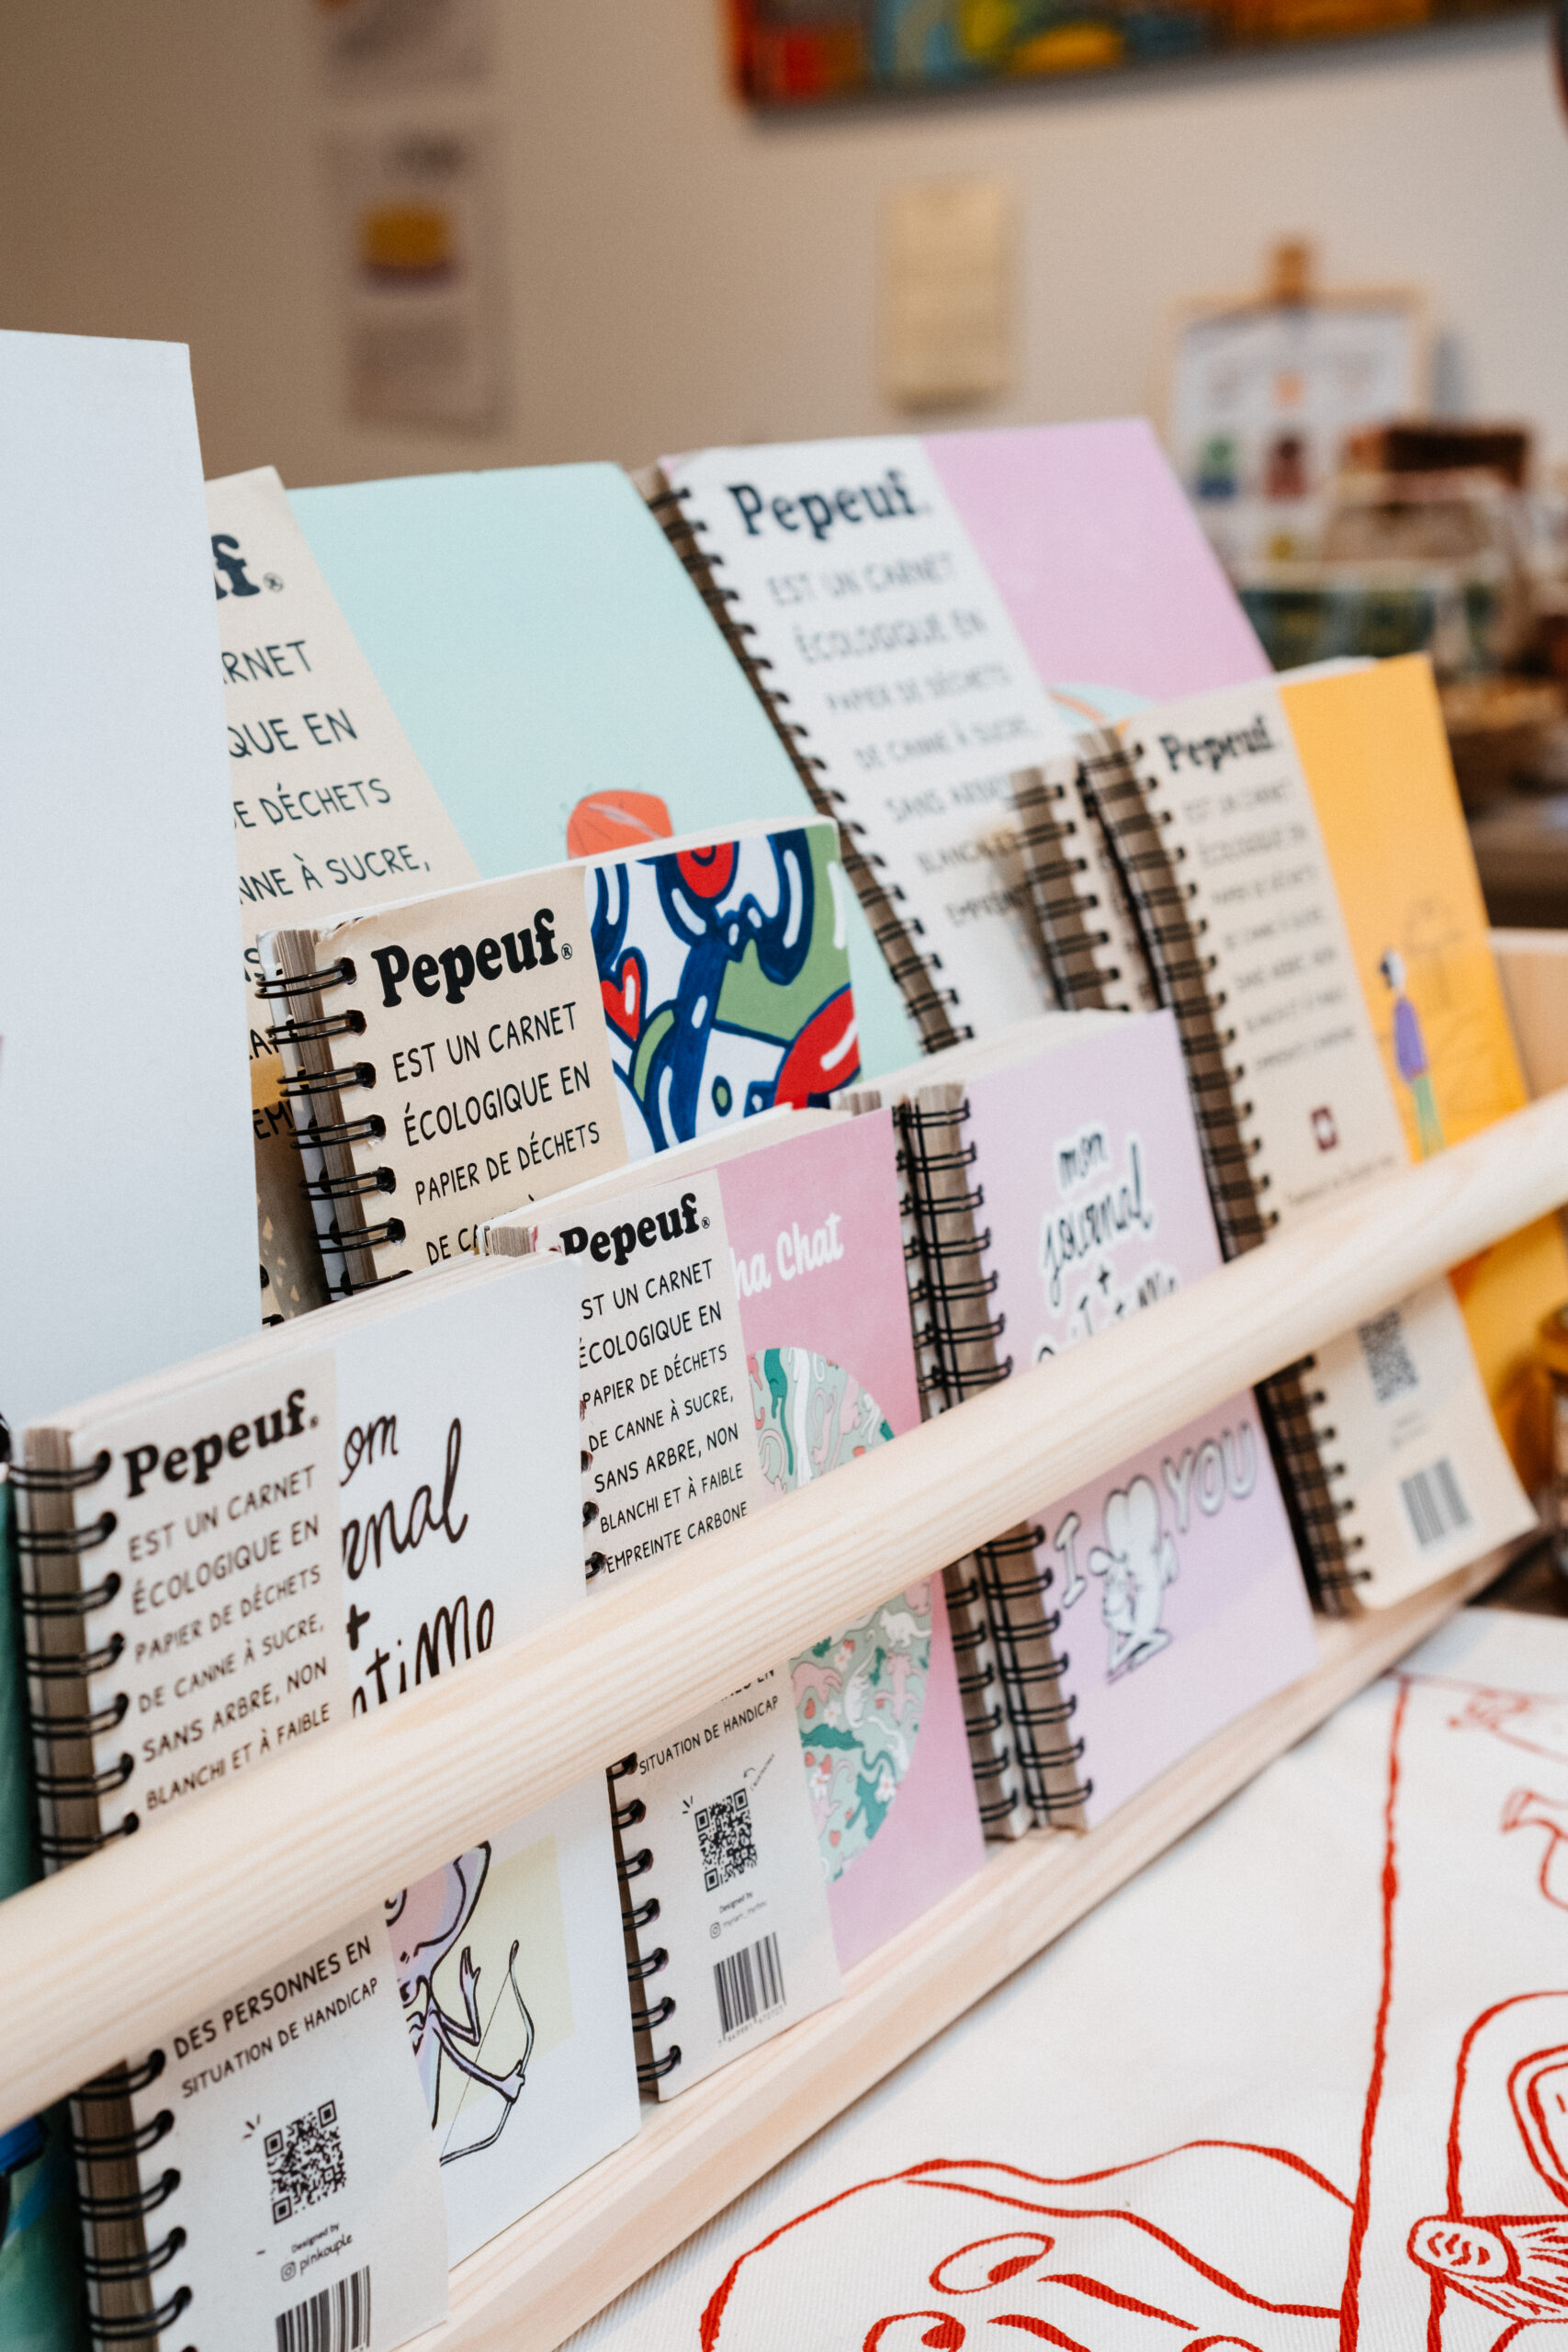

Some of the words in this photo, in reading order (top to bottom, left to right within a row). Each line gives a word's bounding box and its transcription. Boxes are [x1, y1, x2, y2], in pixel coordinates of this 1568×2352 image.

[221, 640, 311, 684] RNET
[302, 708, 357, 745] EN
[233, 800, 256, 829] E
[259, 778, 390, 824] DÉCHETS
[239, 868, 294, 904] NNE
[293, 853, 323, 890] À
[326, 844, 430, 885] SUCRE,
[392, 1042, 435, 1082] EST
[446, 1030, 480, 1066] UN
[489, 1001, 577, 1054] CARNET
[404, 1071, 553, 1147] ÉCOLOGIQUE
[561, 1060, 591, 1096] EN
[414, 1162, 479, 1205] PAPIER
[486, 1150, 512, 1182] DE
[517, 1121, 600, 1170] DÉCHETS
[426, 1235, 452, 1265] DE
[776, 1212, 844, 1281] Chat
[581, 1294, 604, 1320] ST
[613, 1283, 639, 1309] UN
[646, 1259, 712, 1298] CARNET
[580, 1310, 693, 1368] ÉCOLOGIQUE
[698, 1301, 722, 1327] EN
[582, 1377, 635, 1407] PAPIER
[640, 1369, 660, 1391] DE
[663, 1344, 728, 1382] DÉCHETS
[589, 1430, 609, 1452] DE
[615, 1409, 665, 1442] CANNE
[670, 1398, 680, 1422] À
[684, 1385, 734, 1417] SUCRE,
[594, 1461, 639, 1493] SANS
[646, 1439, 703, 1475] ARBRE,
[706, 1422, 739, 1451] NON
[1163, 1420, 1258, 1533] YOU
[128, 1521, 175, 1563] EST
[185, 1505, 219, 1538] UN
[228, 1464, 315, 1521] CARNET
[600, 1496, 660, 1533] BLANCHI
[664, 1487, 682, 1509] ET
[688, 1476, 697, 1499] À
[701, 1463, 743, 1493] FAIBLE
[131, 1530, 281, 1615] ÉCOLOGIQUE
[290, 1514, 319, 1546] EN
[606, 1529, 682, 1574] EMPREINTE
[687, 1500, 748, 1540] CARBONE
[135, 1619, 202, 1664] PAPIER
[209, 1605, 232, 1633] DE
[240, 1565, 321, 1618] DÉCHETS
[138, 1685, 164, 1713] DE
[174, 1653, 236, 1699] CANNE
[243, 1638, 255, 1666] À
[141, 1718, 204, 1763] SANS
[211, 1682, 280, 1733] ARBRE,
[287, 1656, 328, 1693] NON
[146, 1757, 227, 1810] BLANCHI
[231, 1742, 253, 1771] ET
[259, 1728, 271, 1755] À
[276, 1702, 331, 1746] FAIBLE
[638, 1732, 702, 1776] SITUATION
[704, 1724, 721, 1748] DE
[724, 1695, 780, 1735] HANDICAP
[174, 2019, 218, 2059] DES
[223, 1952, 342, 2032] PERSONNES
[346, 1936, 372, 1965] EN
[181, 2038, 274, 2098] SITUATION
[277, 2018, 300, 2047] DE
[305, 1978, 378, 2031] HANDICAP
[291, 2225, 329, 2254] Designed
[299, 2233, 354, 2276] pinkouple
